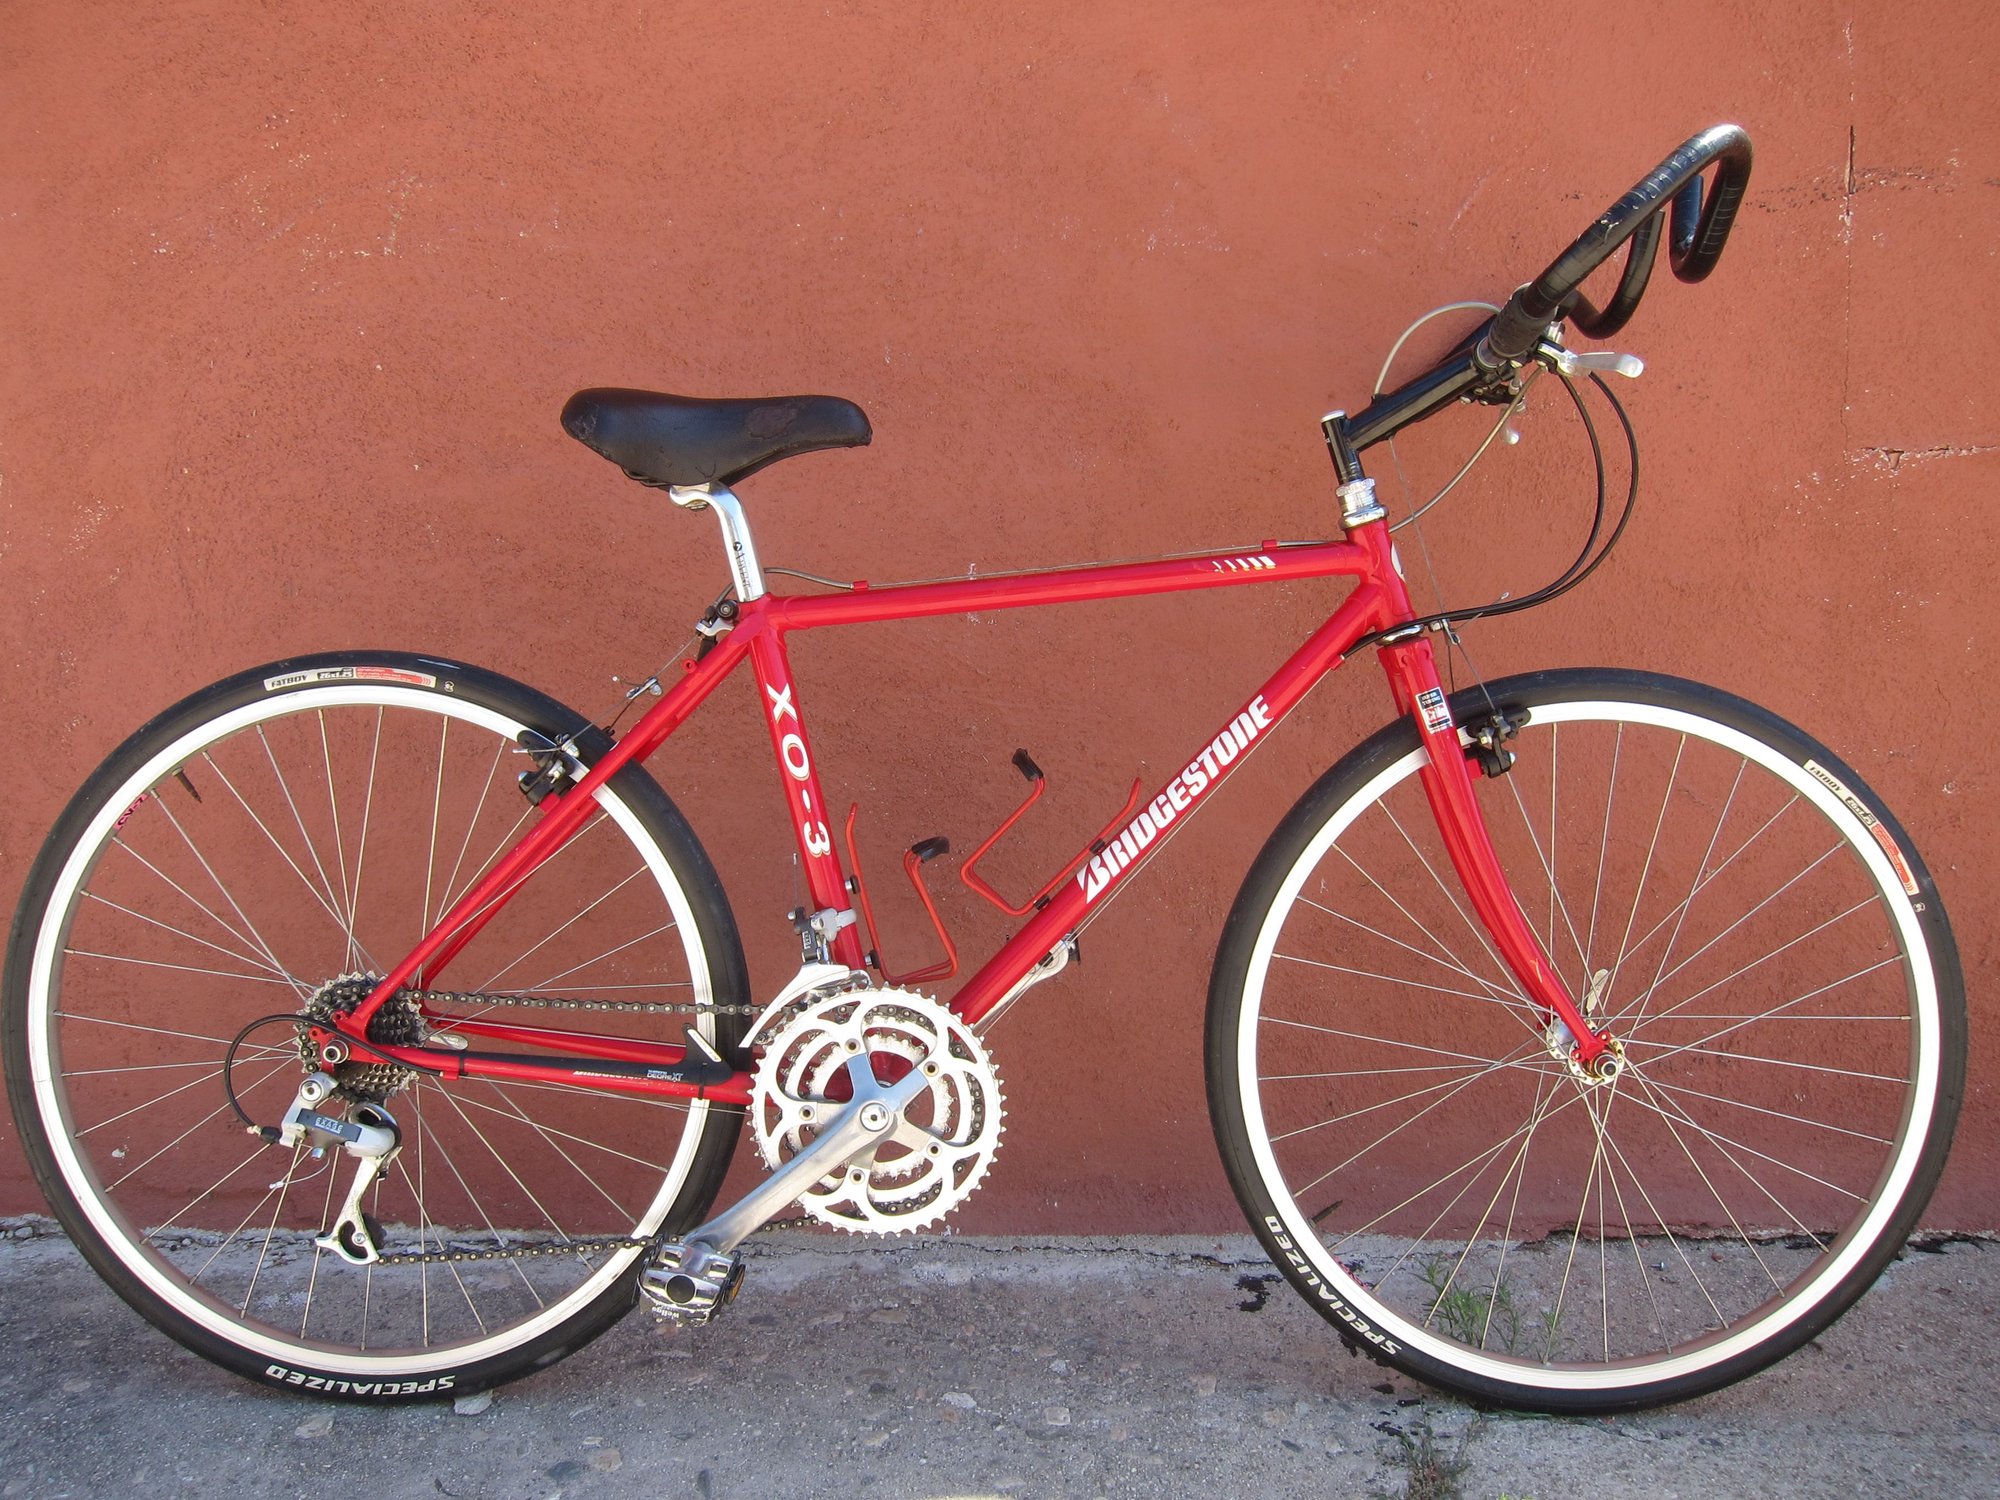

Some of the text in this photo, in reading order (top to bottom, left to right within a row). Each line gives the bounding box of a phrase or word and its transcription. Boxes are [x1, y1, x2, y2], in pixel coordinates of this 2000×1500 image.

[271, 675, 307, 688] FATBOY
[1076, 694, 1274, 904] BRIDGESTONE
[315, 1117, 344, 1132] EXAGE
[1264, 1215, 1402, 1355] SPECIALIZED
[265, 1364, 456, 1395] SPECIALIZED
